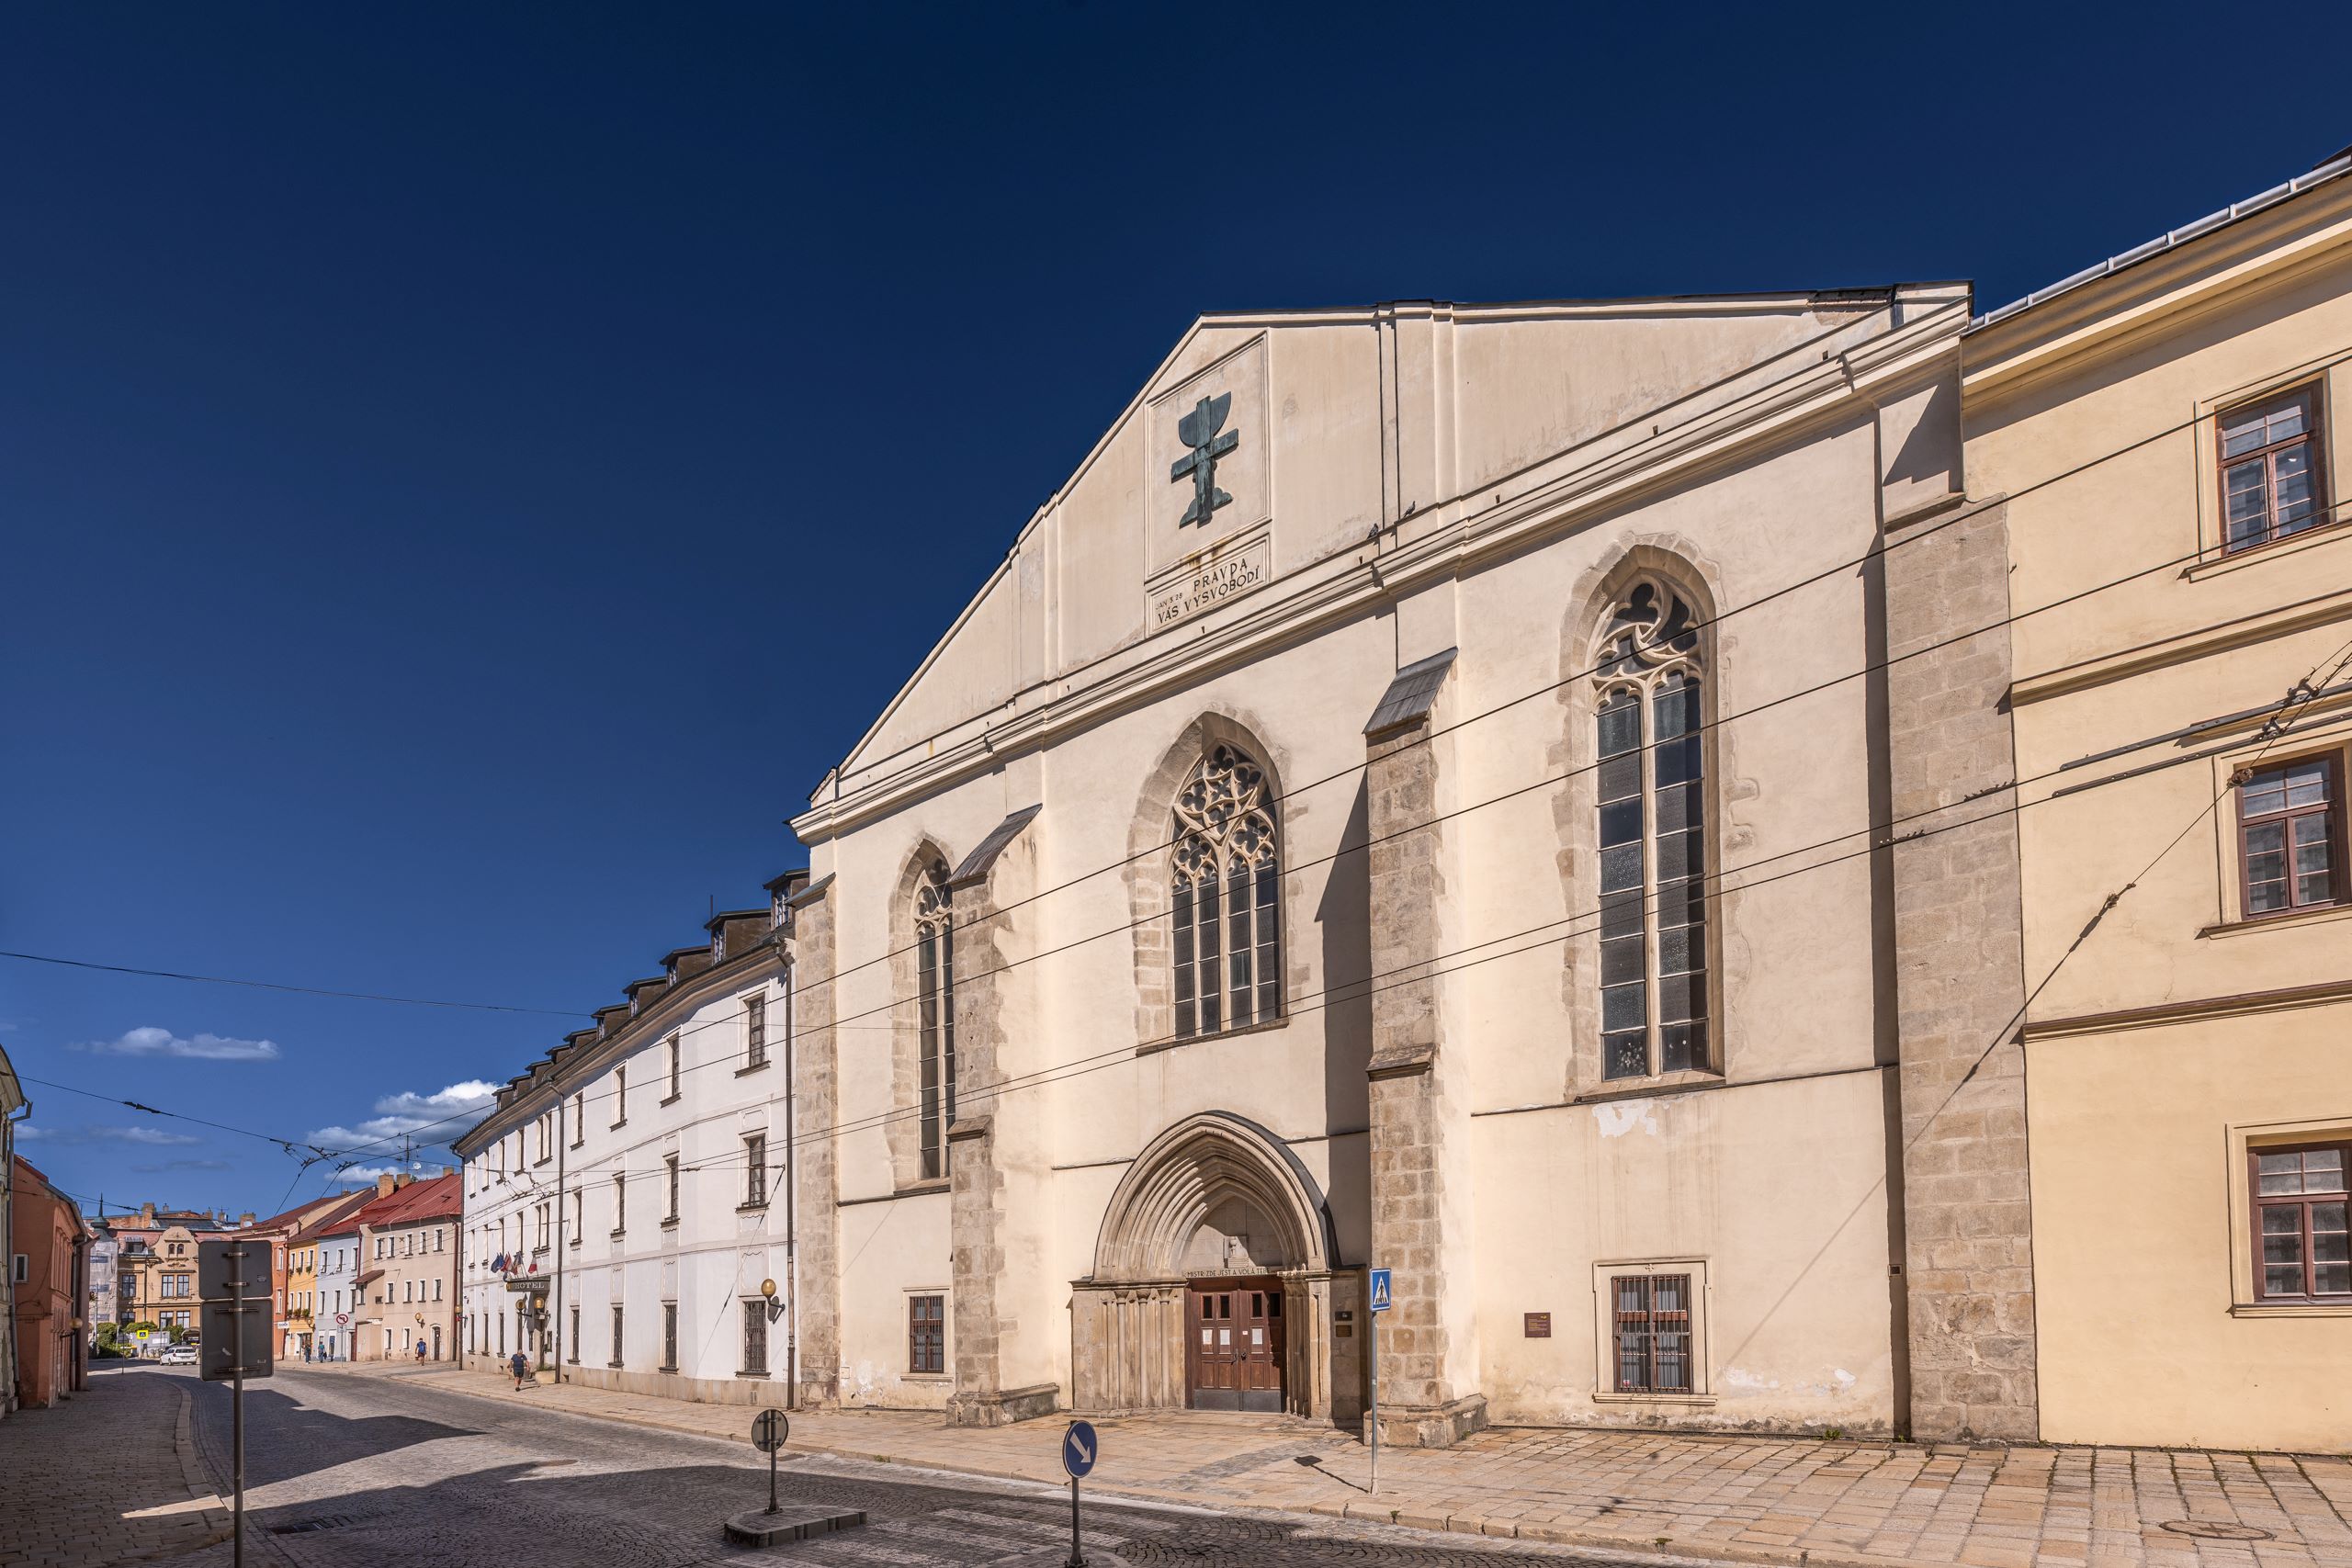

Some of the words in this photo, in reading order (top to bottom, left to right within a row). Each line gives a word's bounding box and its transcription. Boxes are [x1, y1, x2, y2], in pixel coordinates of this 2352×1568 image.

[1193, 558, 1248, 592] PRAVDA
[1158, 605, 1179, 624] VÁS
[1184, 564, 1260, 612] VYSVOBODÍ
[514, 1281, 544, 1290] HOTEL
